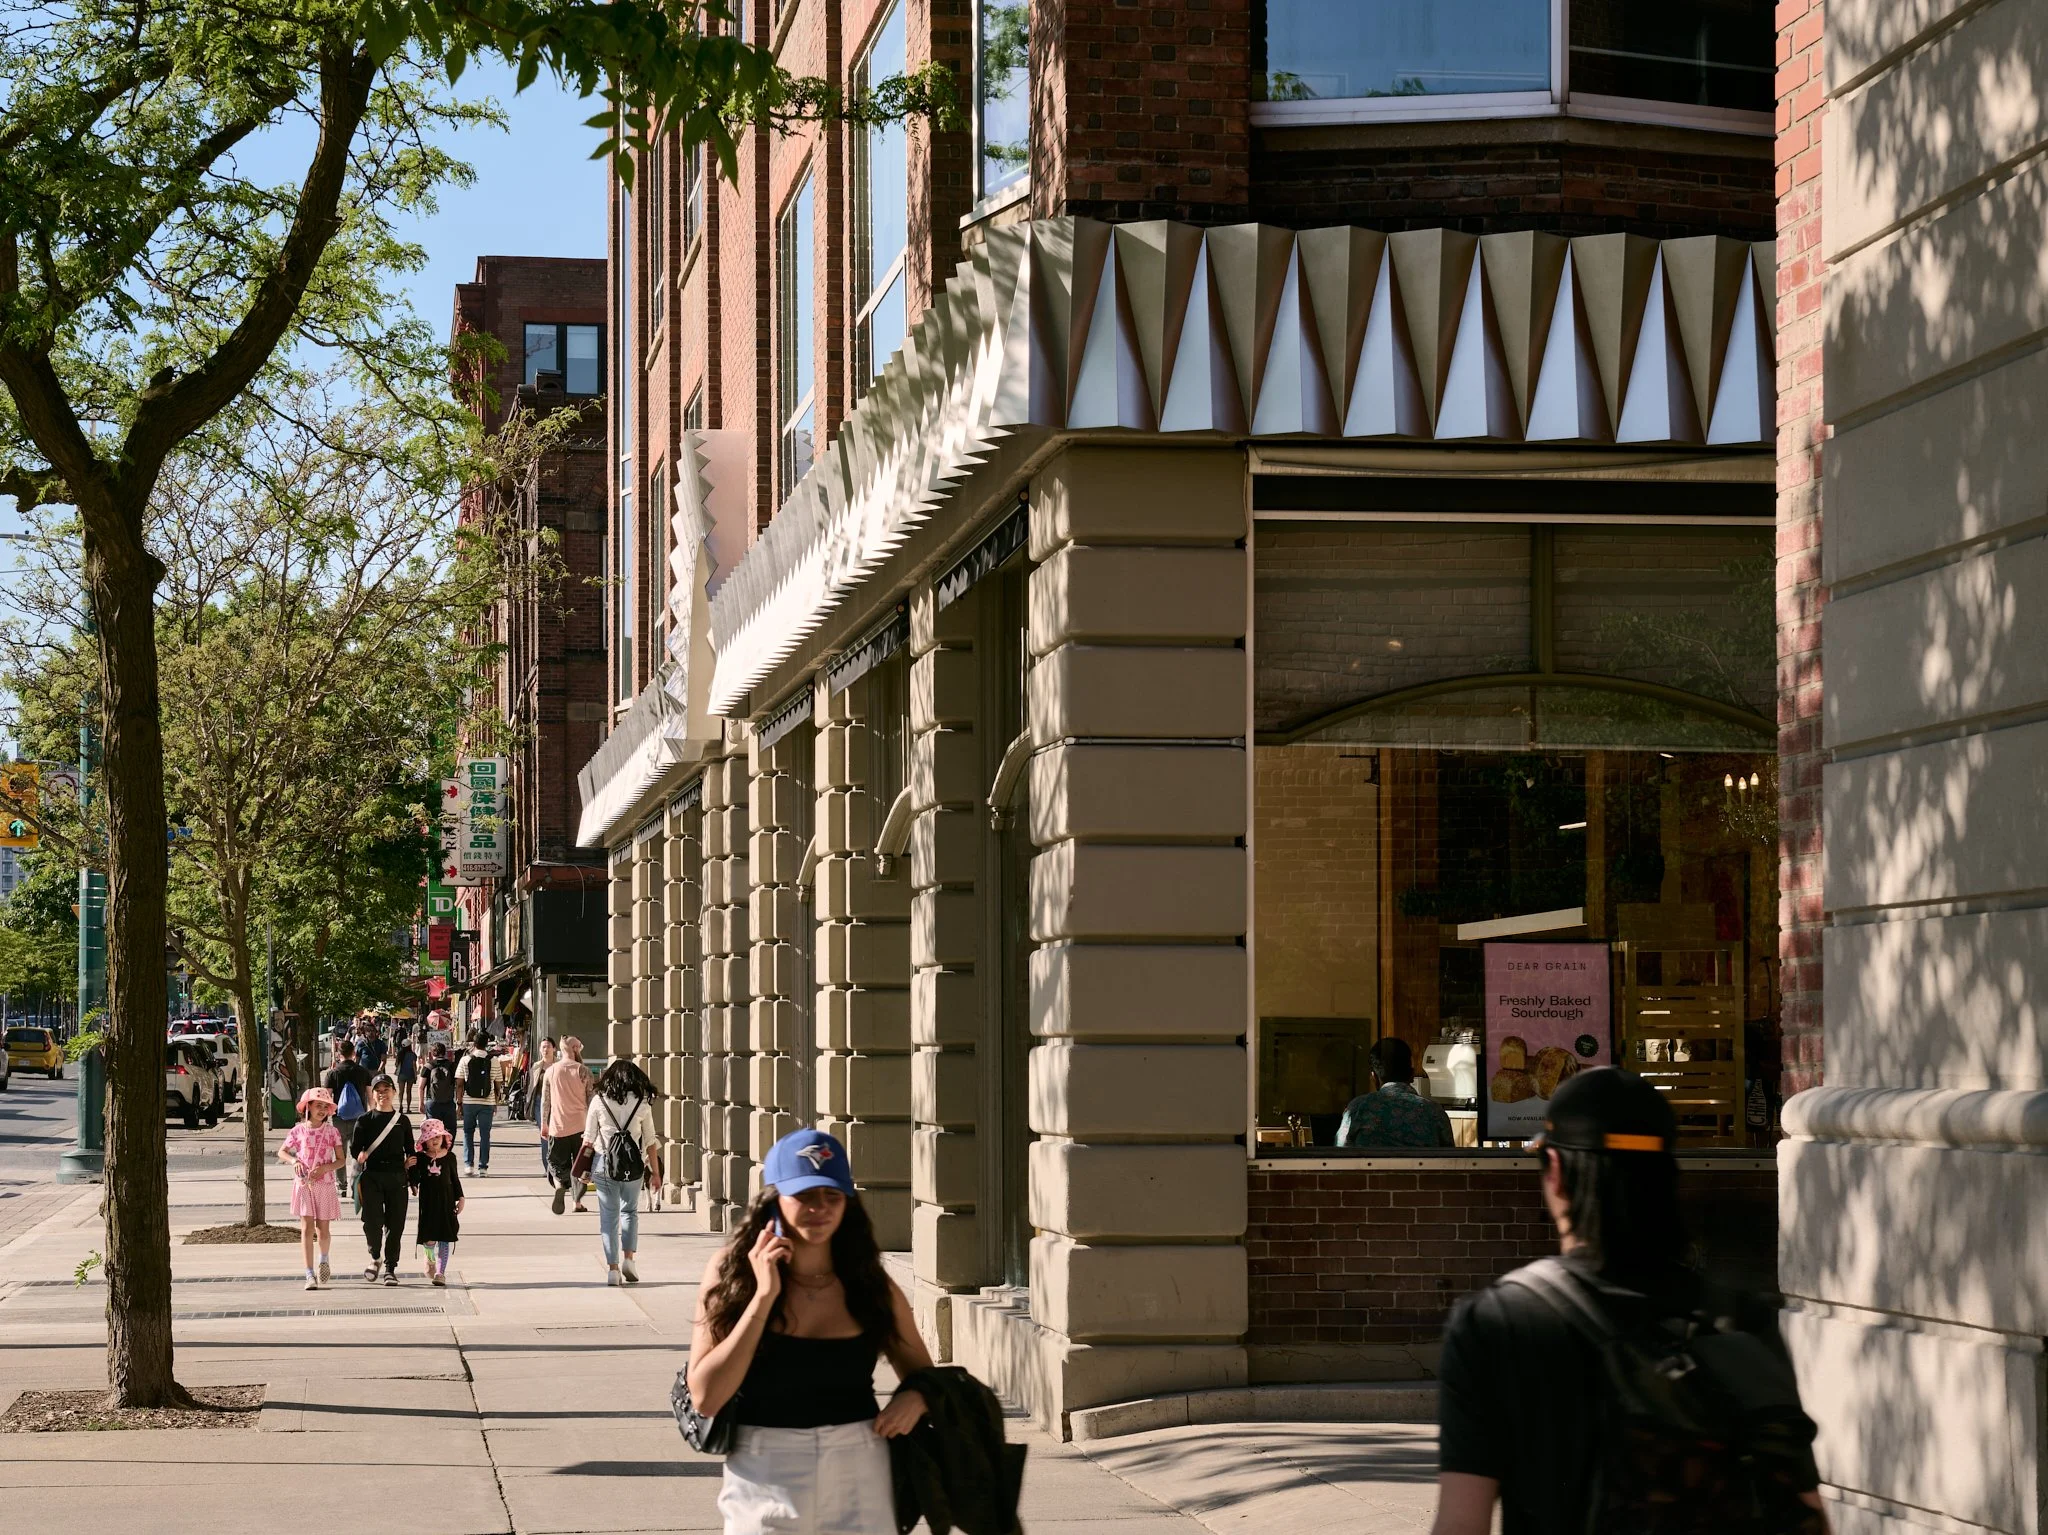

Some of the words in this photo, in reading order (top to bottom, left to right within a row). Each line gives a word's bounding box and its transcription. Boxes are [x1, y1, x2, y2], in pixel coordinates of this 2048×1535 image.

[431, 897, 453, 912] TD
[1507, 962, 1539, 970] DEAR
[1545, 962, 1587, 970] GRAIN
[1499, 996, 1545, 1008] Freshly
[1550, 996, 1591, 1006] Baked
[1511, 1008, 1583, 1021] Sourdough
